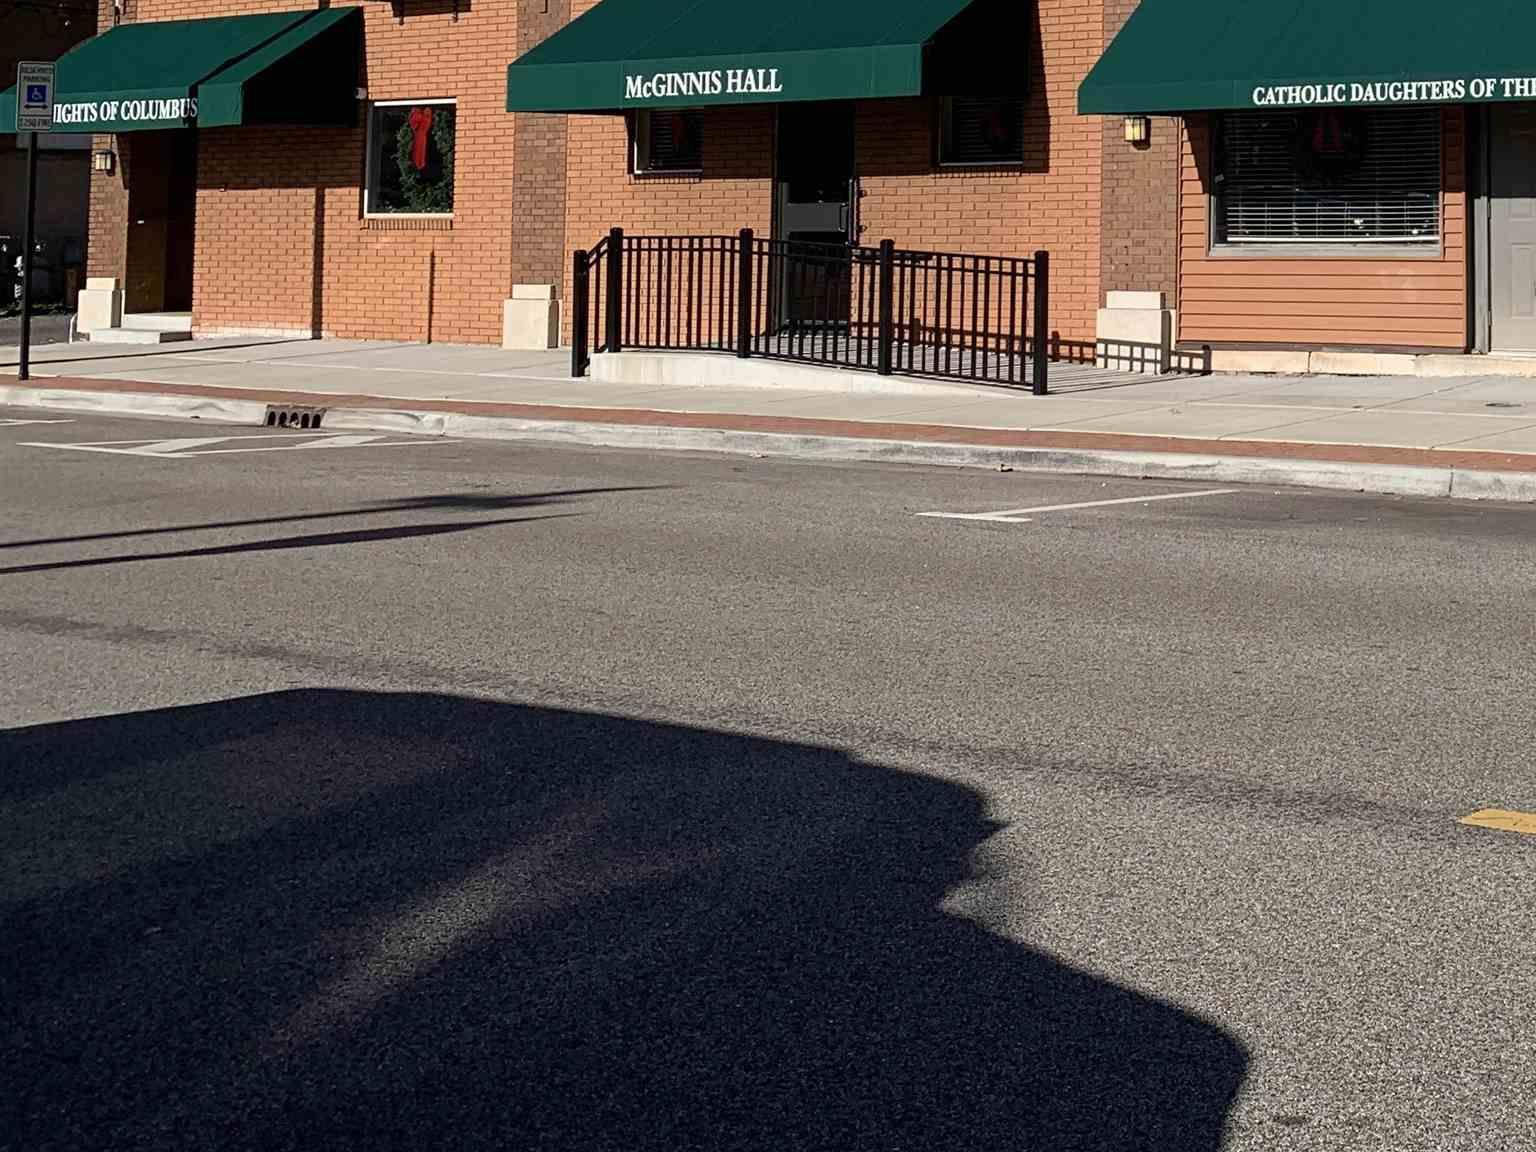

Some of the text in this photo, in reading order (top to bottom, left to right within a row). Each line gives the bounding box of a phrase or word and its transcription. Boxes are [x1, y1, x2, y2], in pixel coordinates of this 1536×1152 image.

[625, 68, 783, 98] McGINNIS HALL
[1252, 83, 1346, 105] CATHOLIC
[1350, 79, 1465, 102] DAUGHTERS
[1469, 78, 1497, 98] OF
[53, 98, 198, 124] IGHTS OF COLUMBUS
